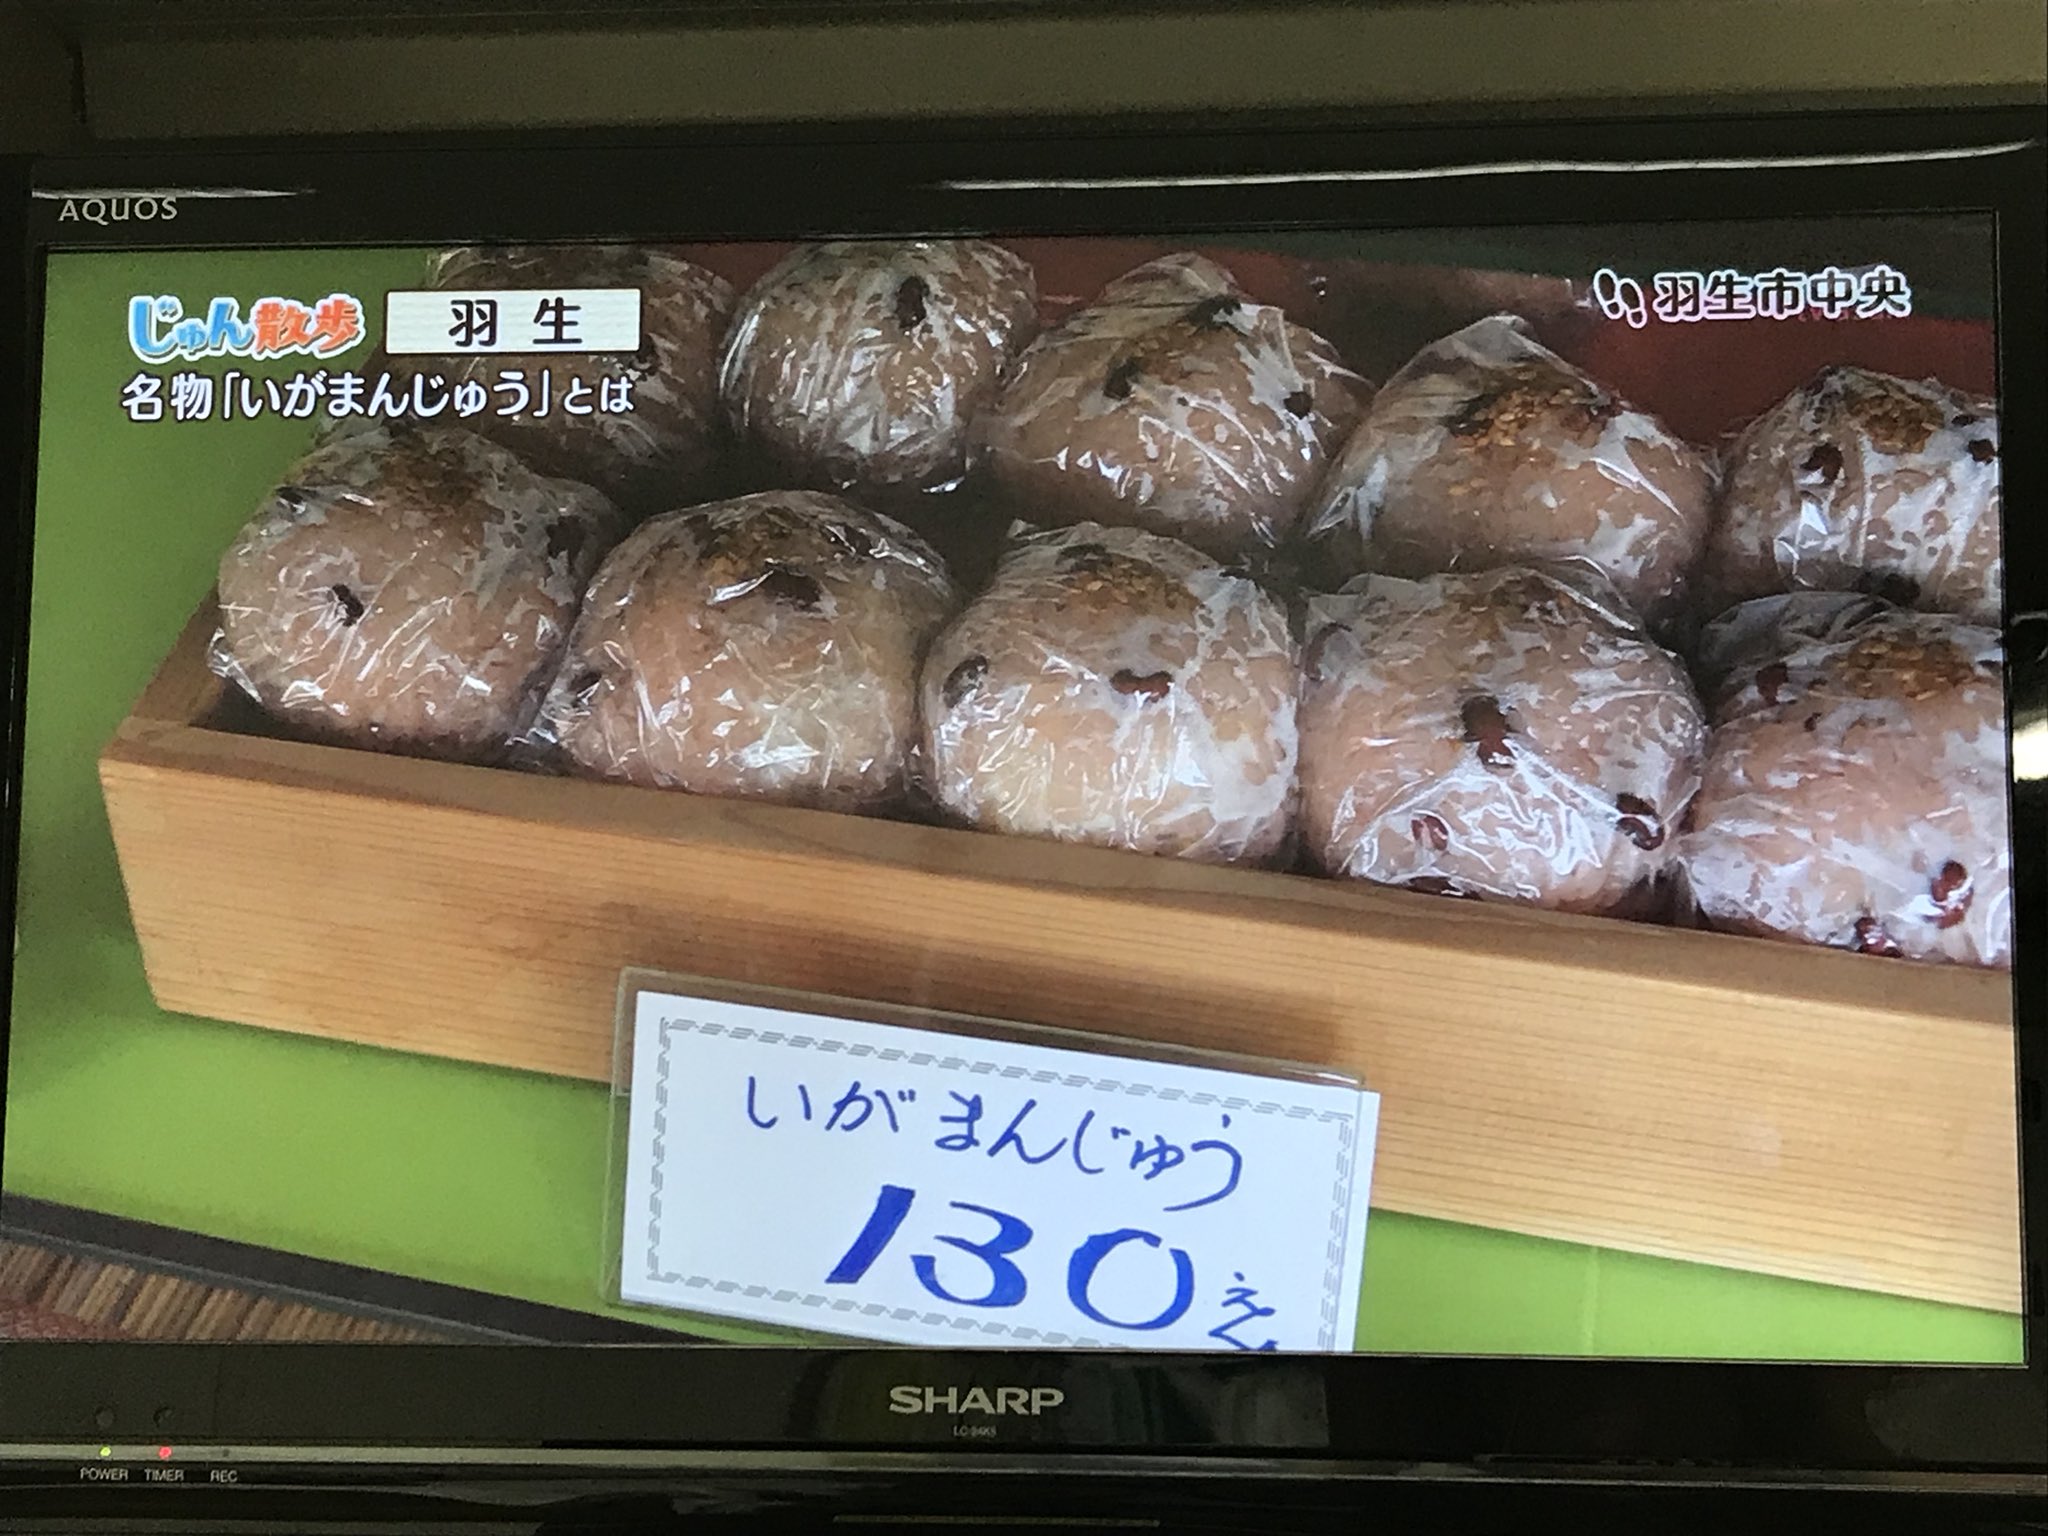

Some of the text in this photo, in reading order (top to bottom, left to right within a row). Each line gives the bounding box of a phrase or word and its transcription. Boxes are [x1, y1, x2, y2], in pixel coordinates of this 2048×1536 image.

[58, 199, 178, 225] AQUOS
[1653, 265, 1911, 322] 羽生市中央
[129, 295, 366, 363] じゅん散歩
[449, 297, 584, 347] 羽生
[122, 370, 634, 421] 名物「いがまんじゅう」とは
[746, 1076, 1242, 1212] いがまんじゅう
[889, 1386, 1065, 1415] SHARP
[80, 1467, 238, 1483] POWER TIMER REC
